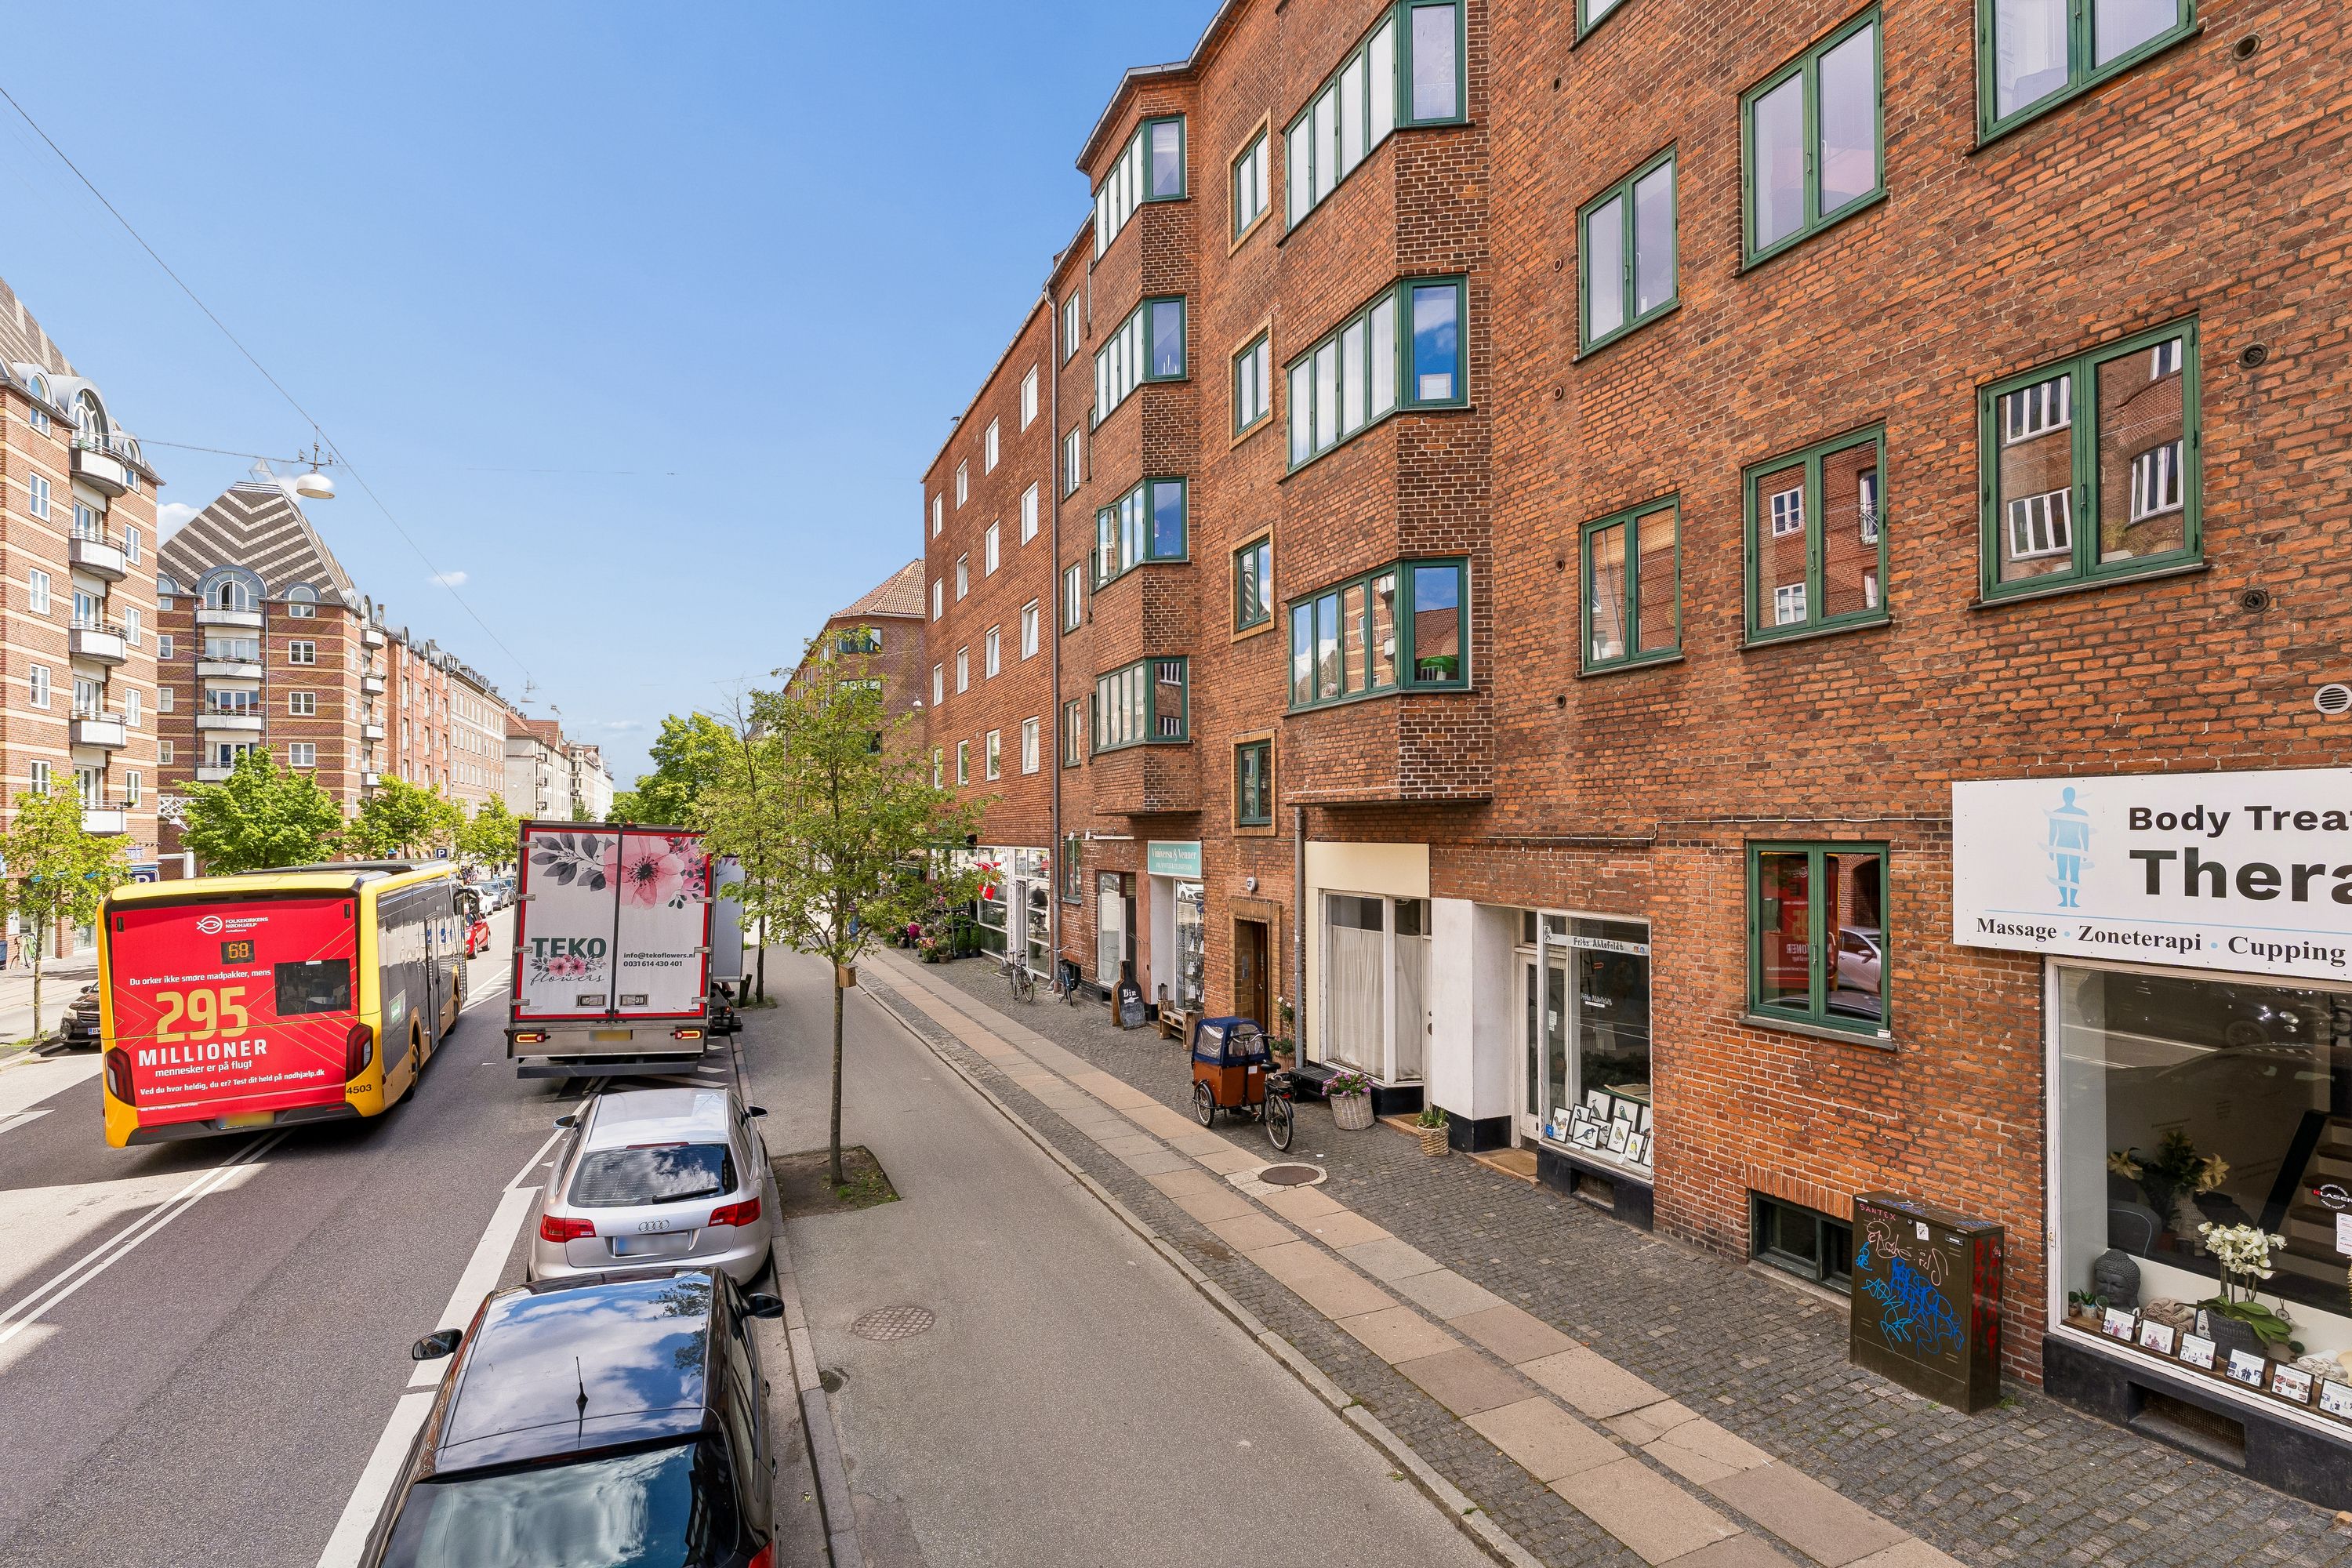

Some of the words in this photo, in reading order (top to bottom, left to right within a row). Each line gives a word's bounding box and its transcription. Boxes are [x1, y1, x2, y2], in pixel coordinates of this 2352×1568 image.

[2129, 804, 2231, 838] Body
[2244, 805, 2352, 831] Trea
[437, 849, 445, 858] P
[1178, 848, 1197, 859] Venner
[228, 942, 249, 959] 68
[531, 937, 607, 959] TEKO
[1573, 937, 1590, 947] Frits
[1592, 938, 1624, 951] Ahlefeldt
[1976, 917, 2057, 942] Massage
[2078, 924, 2202, 954] Zoneterapi
[2228, 935, 2347, 967] Cupping
[142, 976, 162, 985] orker
[164, 975, 180, 983] ikke
[206, 970, 250, 981] madpakker,
[529, 972, 604, 986] flowers
[1123, 989, 1136, 997] Vin
[156, 985, 249, 1044] 295
[138, 1039, 267, 1067] MILLIONER
[155, 1065, 205, 1077] mennesker
[218, 1061, 230, 1073] på
[231, 1059, 252, 1071] flugt
[166, 1084, 183, 1093] hvor
[184, 1082, 208, 1092] heldig,
[248, 1075, 258, 1083] dit
[259, 1074, 273, 1083] held
[274, 1073, 282, 1082] på
[284, 1069, 325, 1080] nødhjælp.dk
[346, 1083, 372, 1094] 4503
[1859, 1203, 1896, 1221] SANTEX
